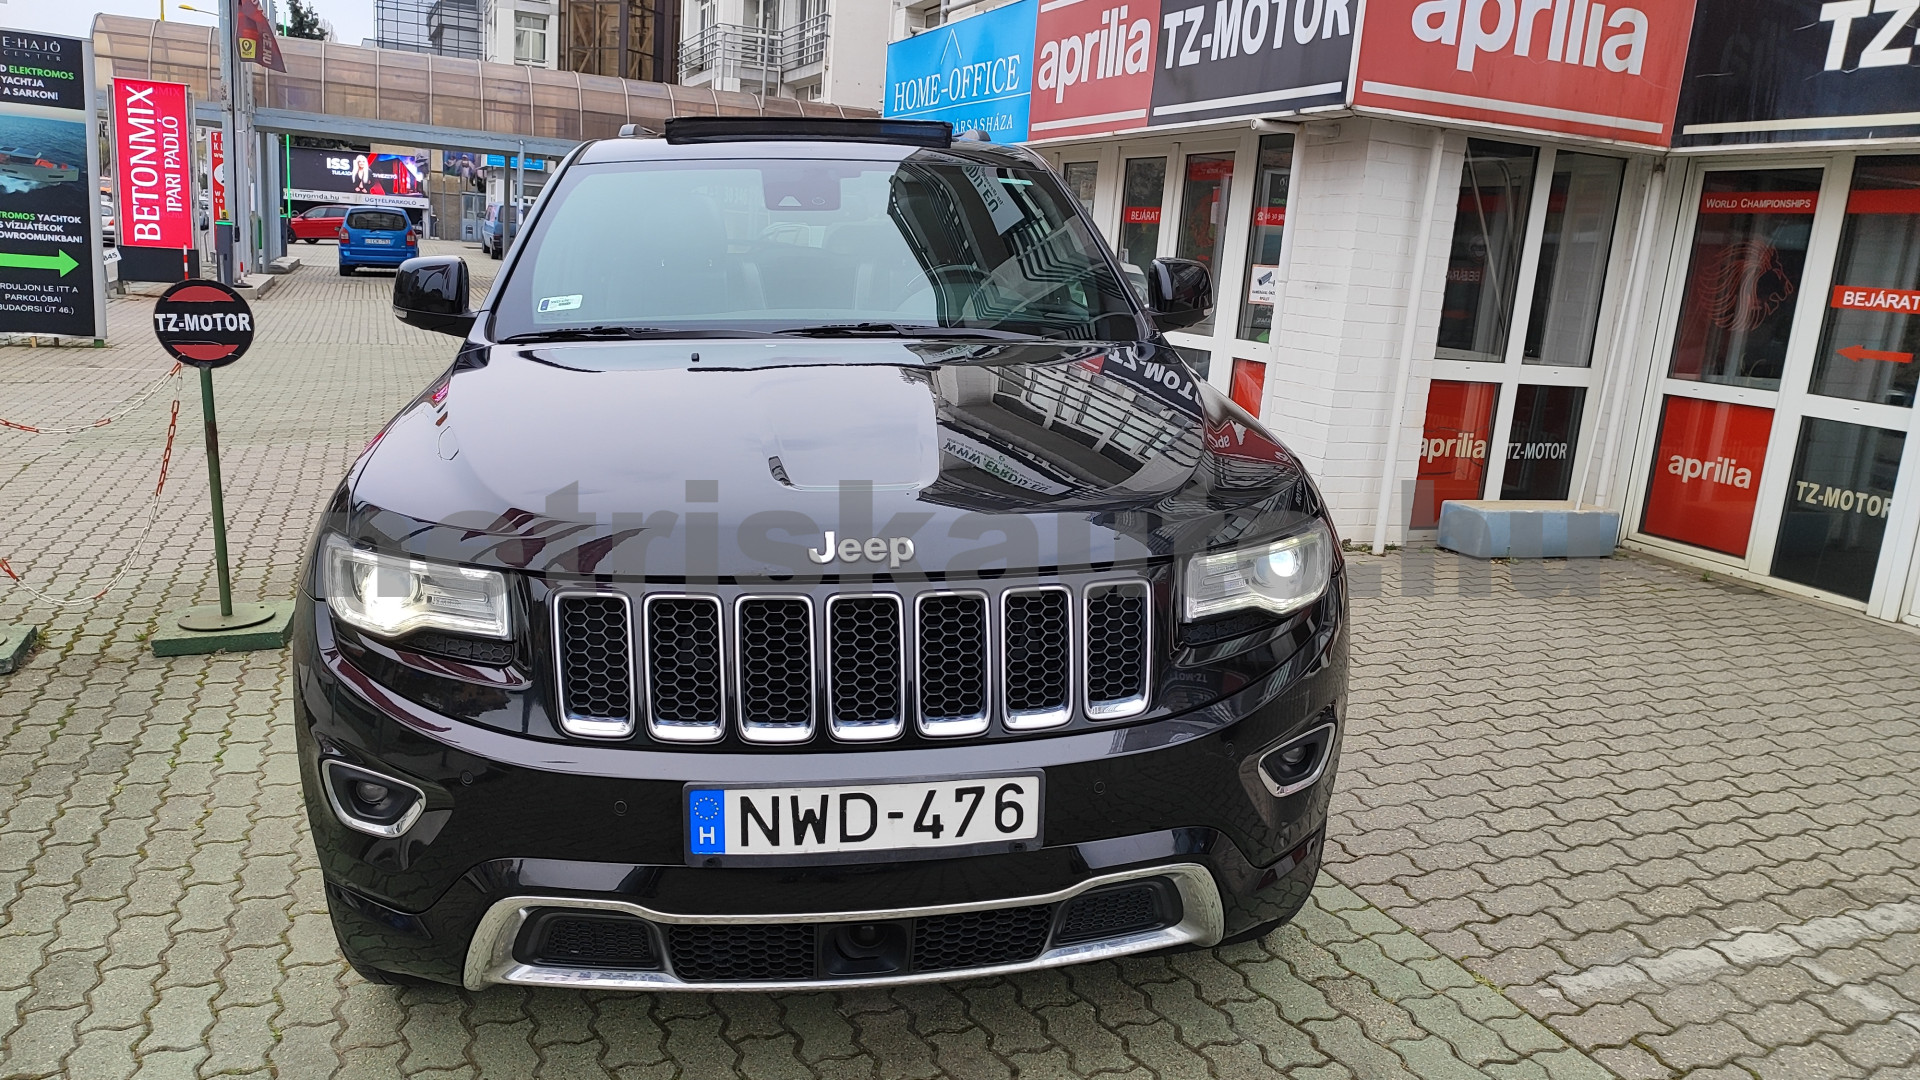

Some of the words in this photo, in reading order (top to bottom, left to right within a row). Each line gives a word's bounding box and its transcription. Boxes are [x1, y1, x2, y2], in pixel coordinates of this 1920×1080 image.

[1411, 0, 1649, 75] aprilia
[3, 50, 61, 61] CENTER
[1038, 5, 1151, 103] aprilia
[0, 75, 45, 88] YACHTJA
[8, 65, 75, 80] ELEKTROMOS
[893, 54, 1020, 112] HOME-OFFICE
[3, 87, 11, 95] A
[12, 88, 59, 100] SARKON!
[952, 112, 1013, 135] ÁRSASHÁZA
[157, 116, 181, 169] PADLÓ
[126, 85, 162, 242] BETONMIX
[165, 173, 183, 213] IPARI
[1706, 198, 1737, 208] WORLD
[1740, 198, 1811, 209] CHAMPIONSHIPS
[37, 213, 82, 224] YACHTOK
[1131, 209, 1160, 221] BEJÁRAT
[56, 285, 71, 293] ITT
[44, 304, 57, 313] ÚT
[1842, 290, 1920, 311] BEJÁRAT
[154, 313, 252, 332] TZ-MOTOR
[1420, 432, 1487, 464] aprilia
[1508, 442, 1568, 460] TZ-MOTOR
[1667, 454, 1752, 489] aprilia
[1796, 480, 1892, 519] TZ-MOTOR
[808, 530, 915, 569] Jeep
[699, 826, 715, 845] H
[739, 783, 1025, 847] NWD-476
